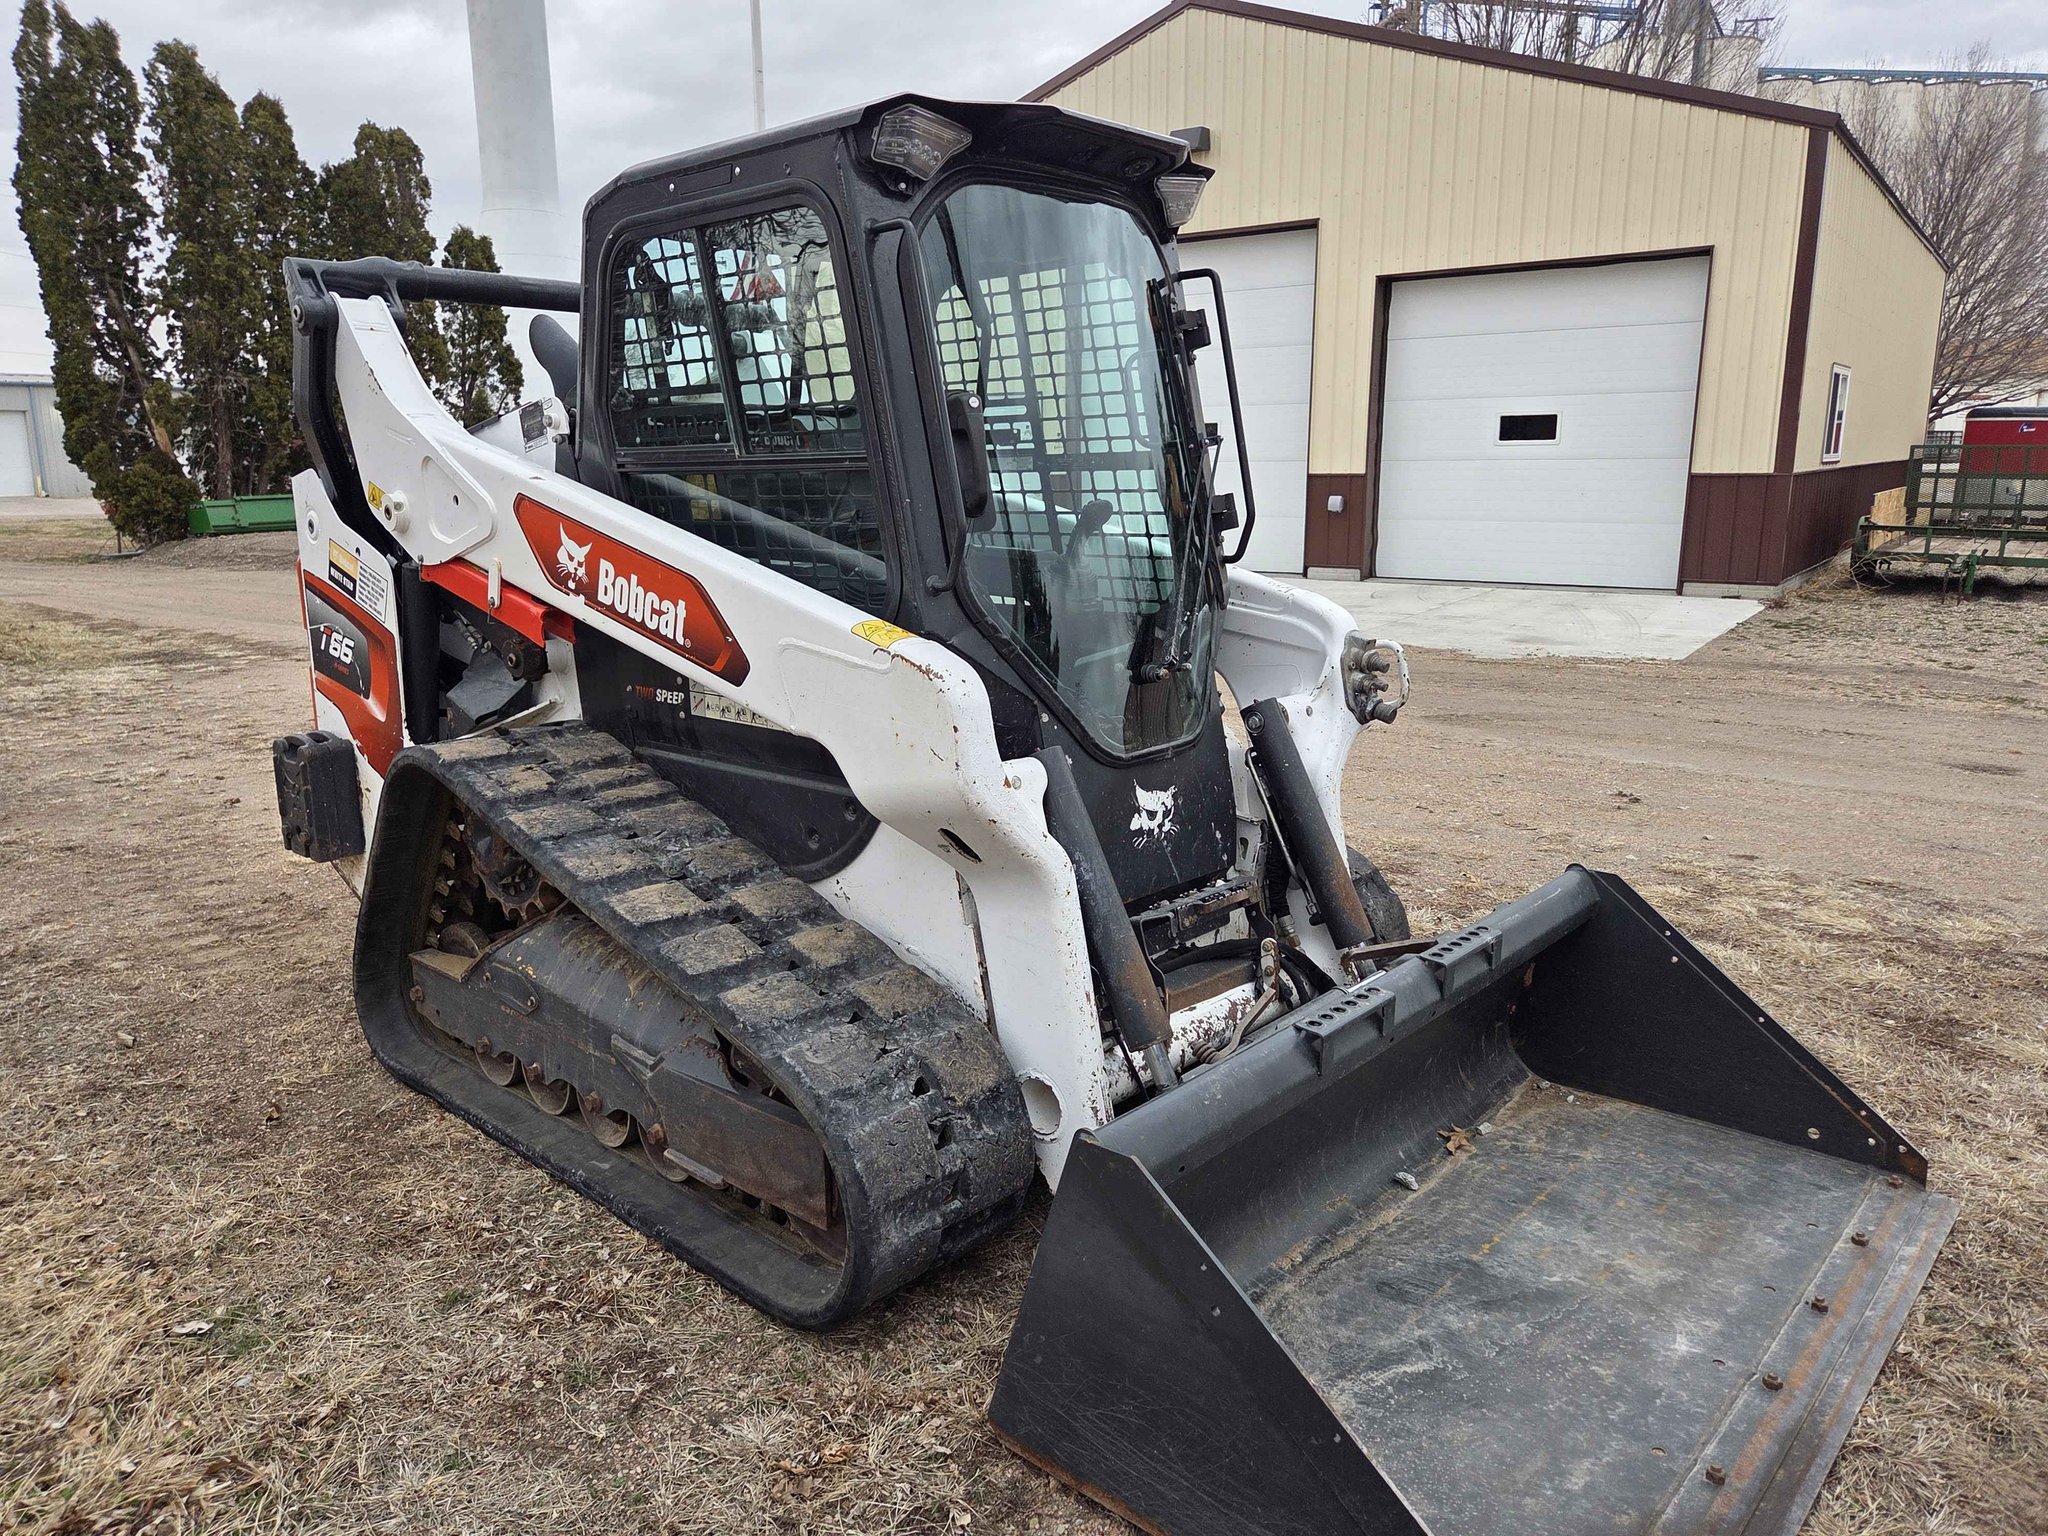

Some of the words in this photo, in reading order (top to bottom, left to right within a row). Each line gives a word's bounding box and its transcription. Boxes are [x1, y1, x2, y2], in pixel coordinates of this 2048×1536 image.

[598, 558, 686, 646] Bobcat
[320, 625, 355, 665] T66
[655, 688, 685, 705] SPEED
